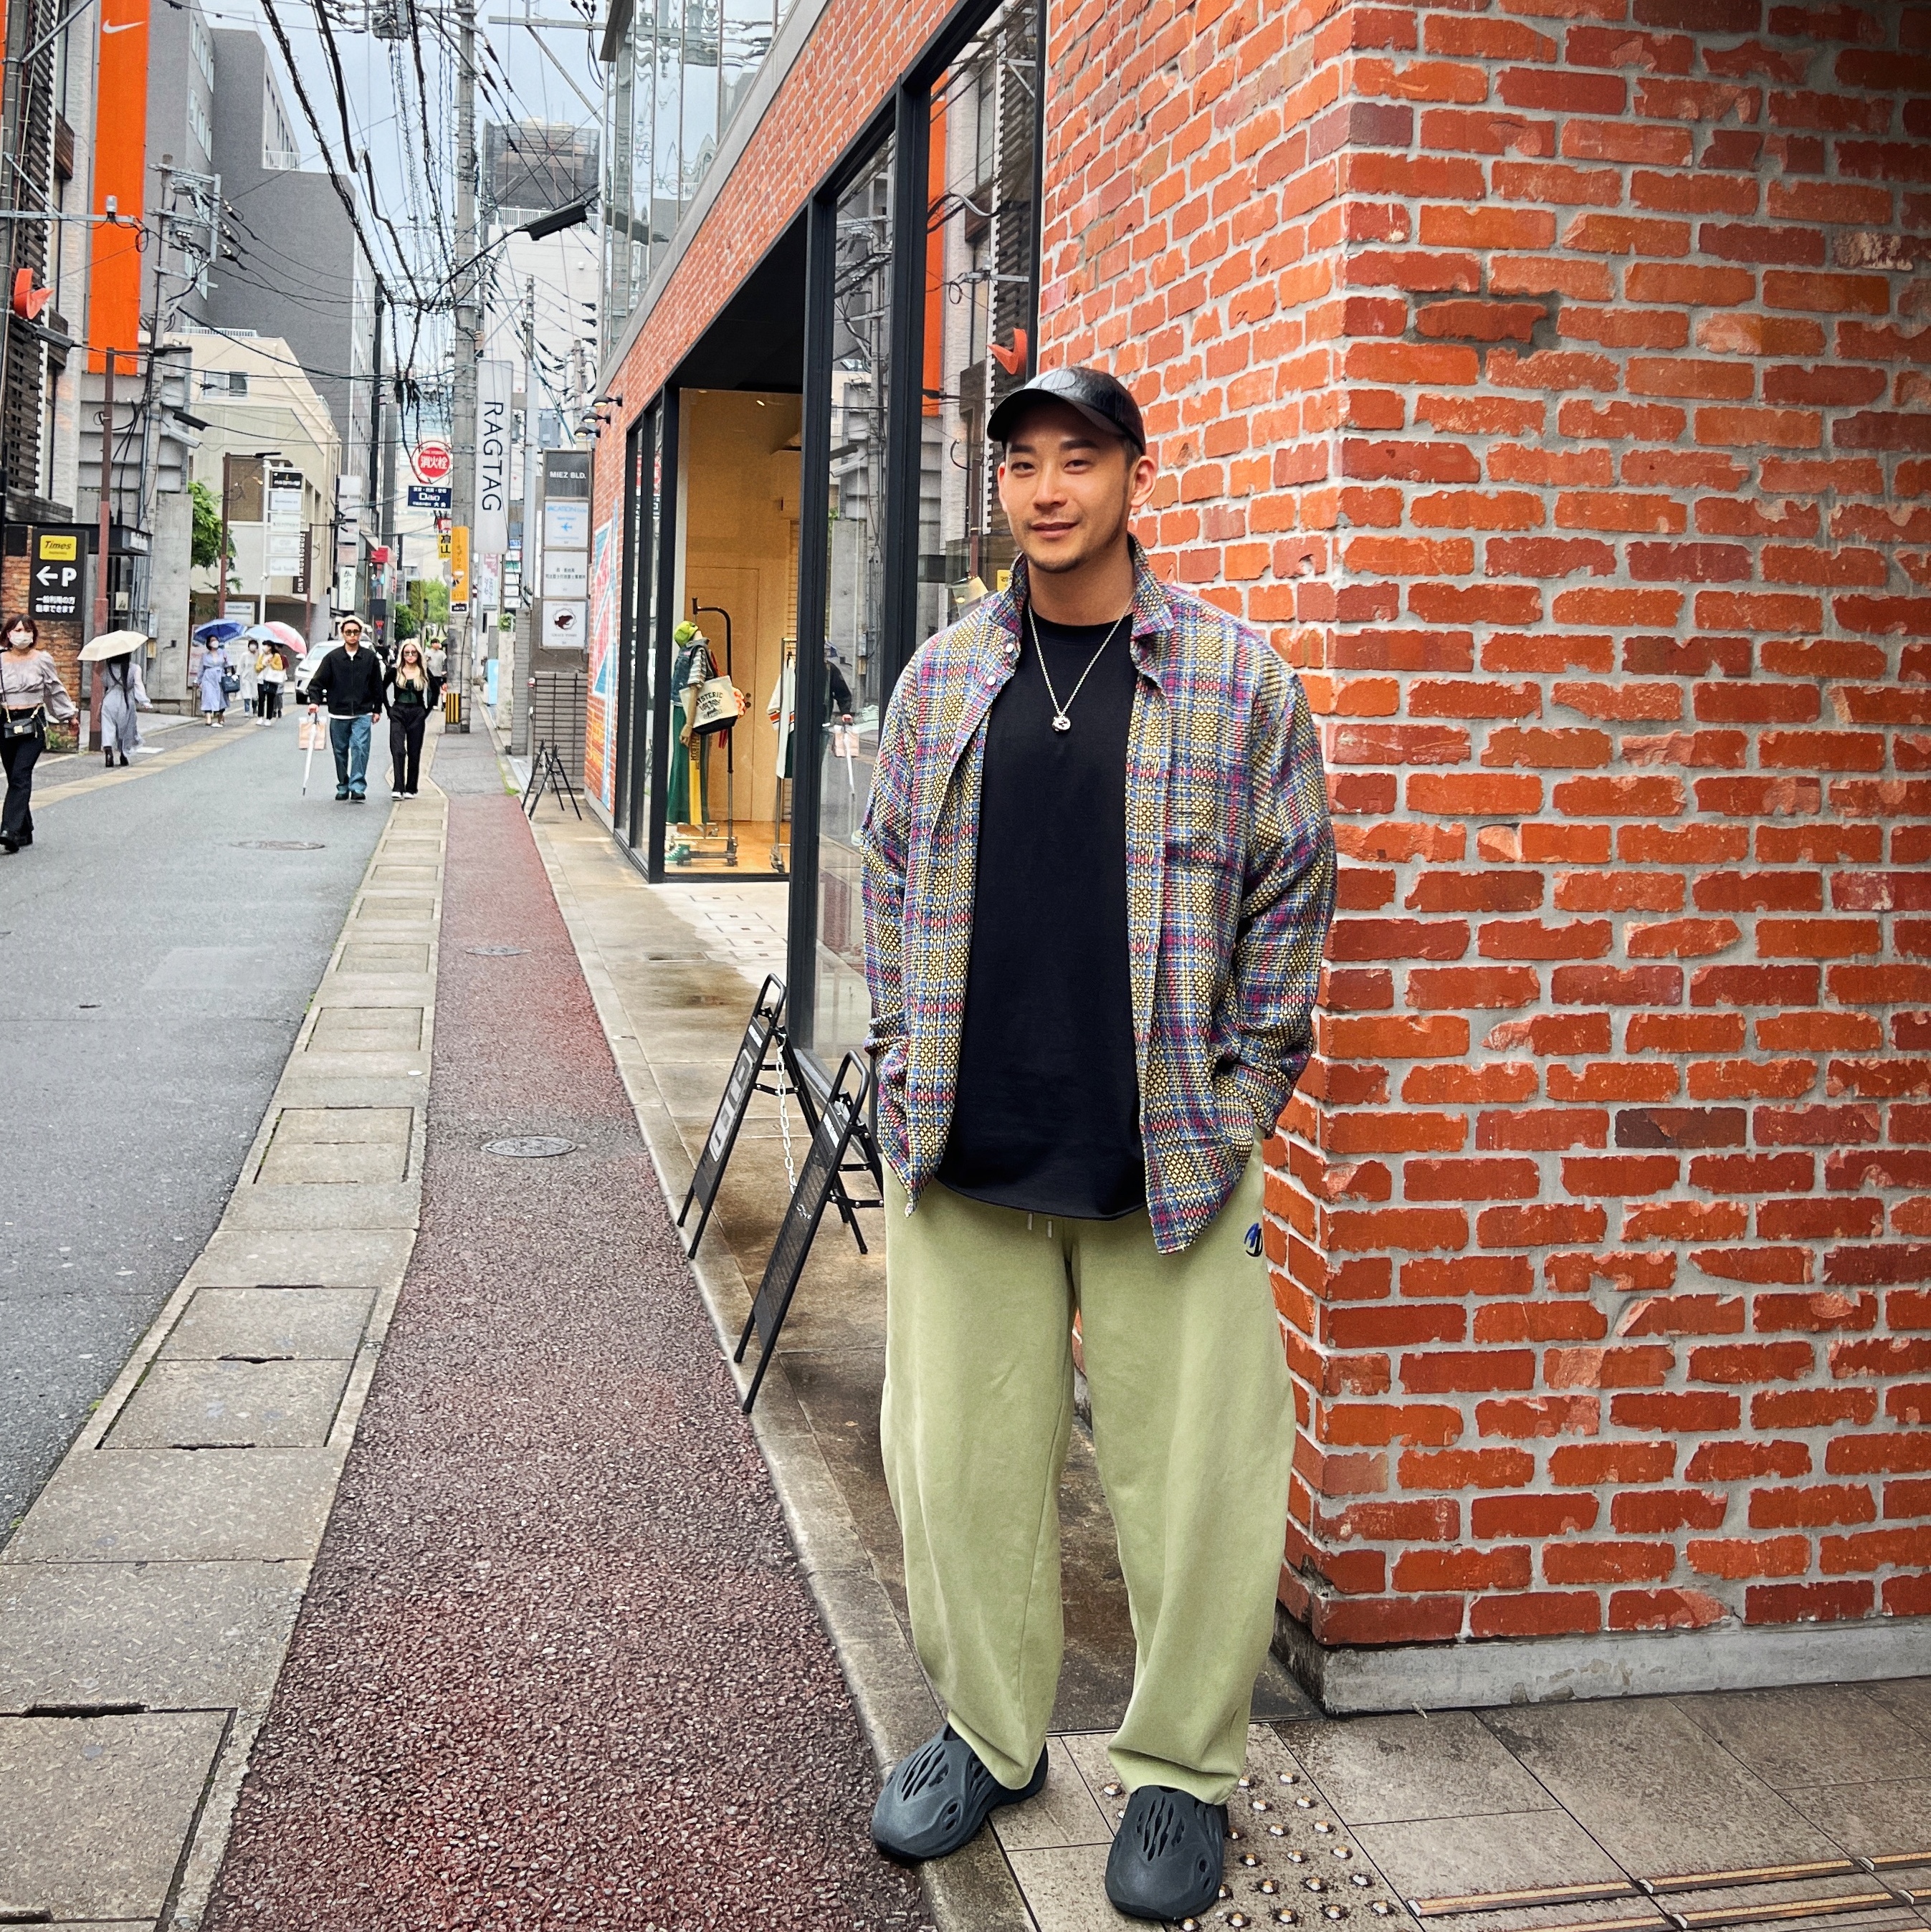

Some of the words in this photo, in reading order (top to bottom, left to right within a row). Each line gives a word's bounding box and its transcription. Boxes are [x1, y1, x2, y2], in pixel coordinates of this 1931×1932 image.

[420, 455, 449, 470] 消火栓
[482, 401, 504, 511] RAGTAG
[44, 540, 72, 550] Times
[62, 567, 77, 588] P
